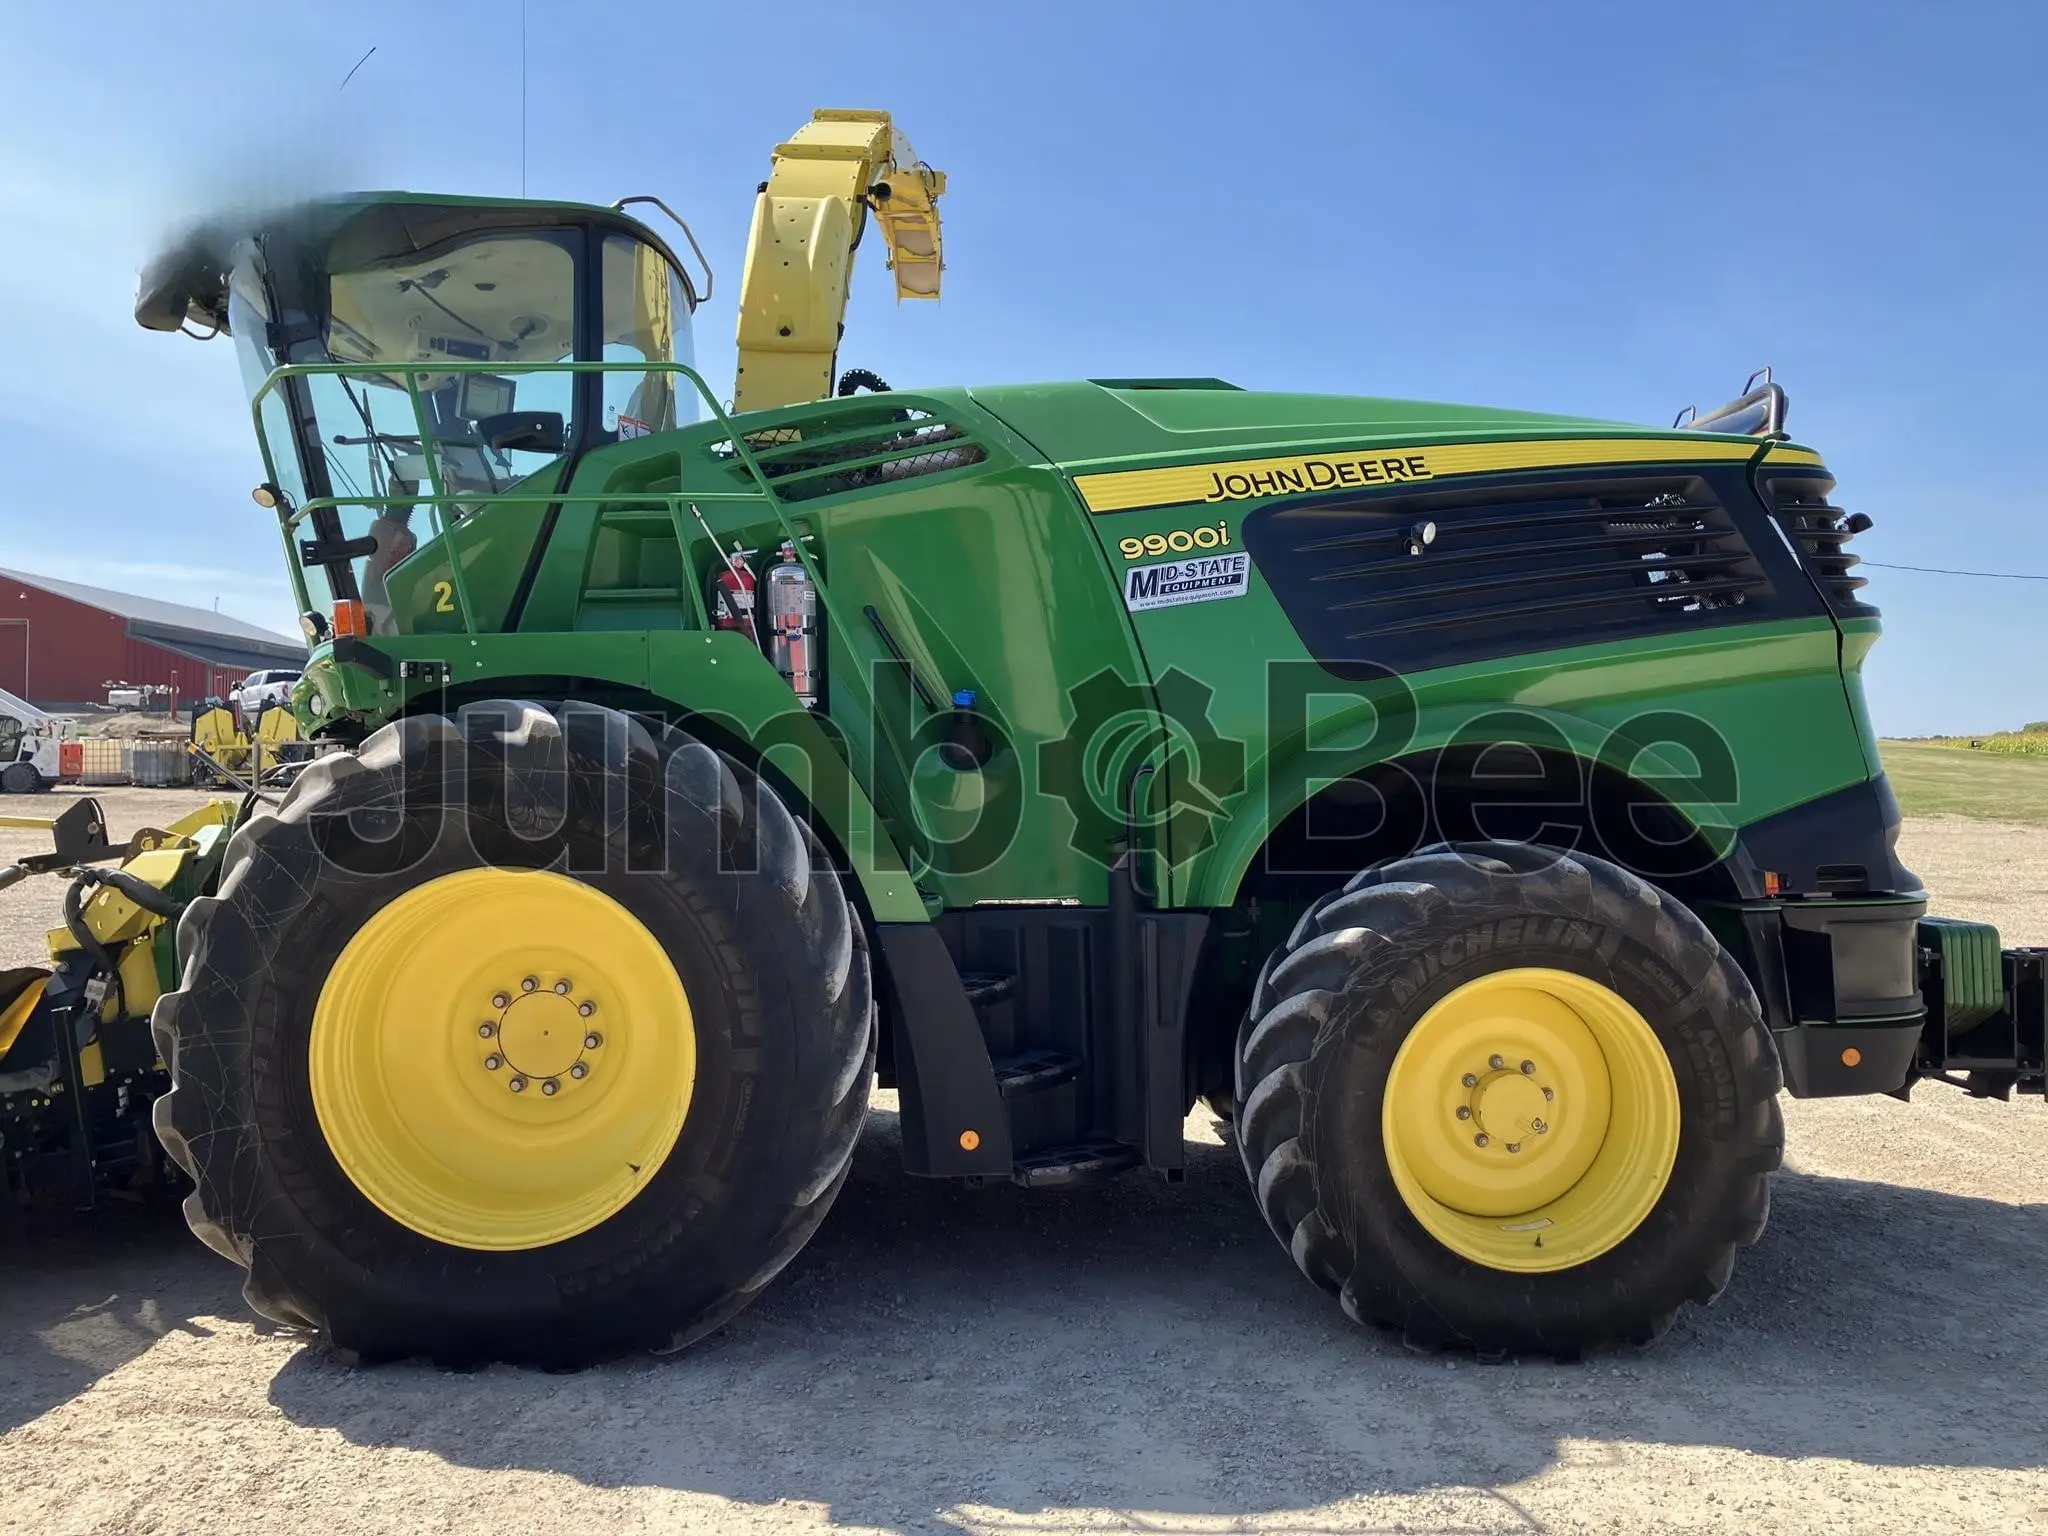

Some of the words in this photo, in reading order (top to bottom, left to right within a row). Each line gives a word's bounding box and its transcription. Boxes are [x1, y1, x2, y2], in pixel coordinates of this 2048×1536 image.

[1206, 471, 1301, 499] JOHN
[1304, 454, 1432, 488] DEERE
[1119, 520, 1231, 560] 9900i
[434, 581, 455, 612] 2
[1130, 556, 1246, 600] MID-STATE
[1164, 575, 1234, 593] EQUIPMENT
